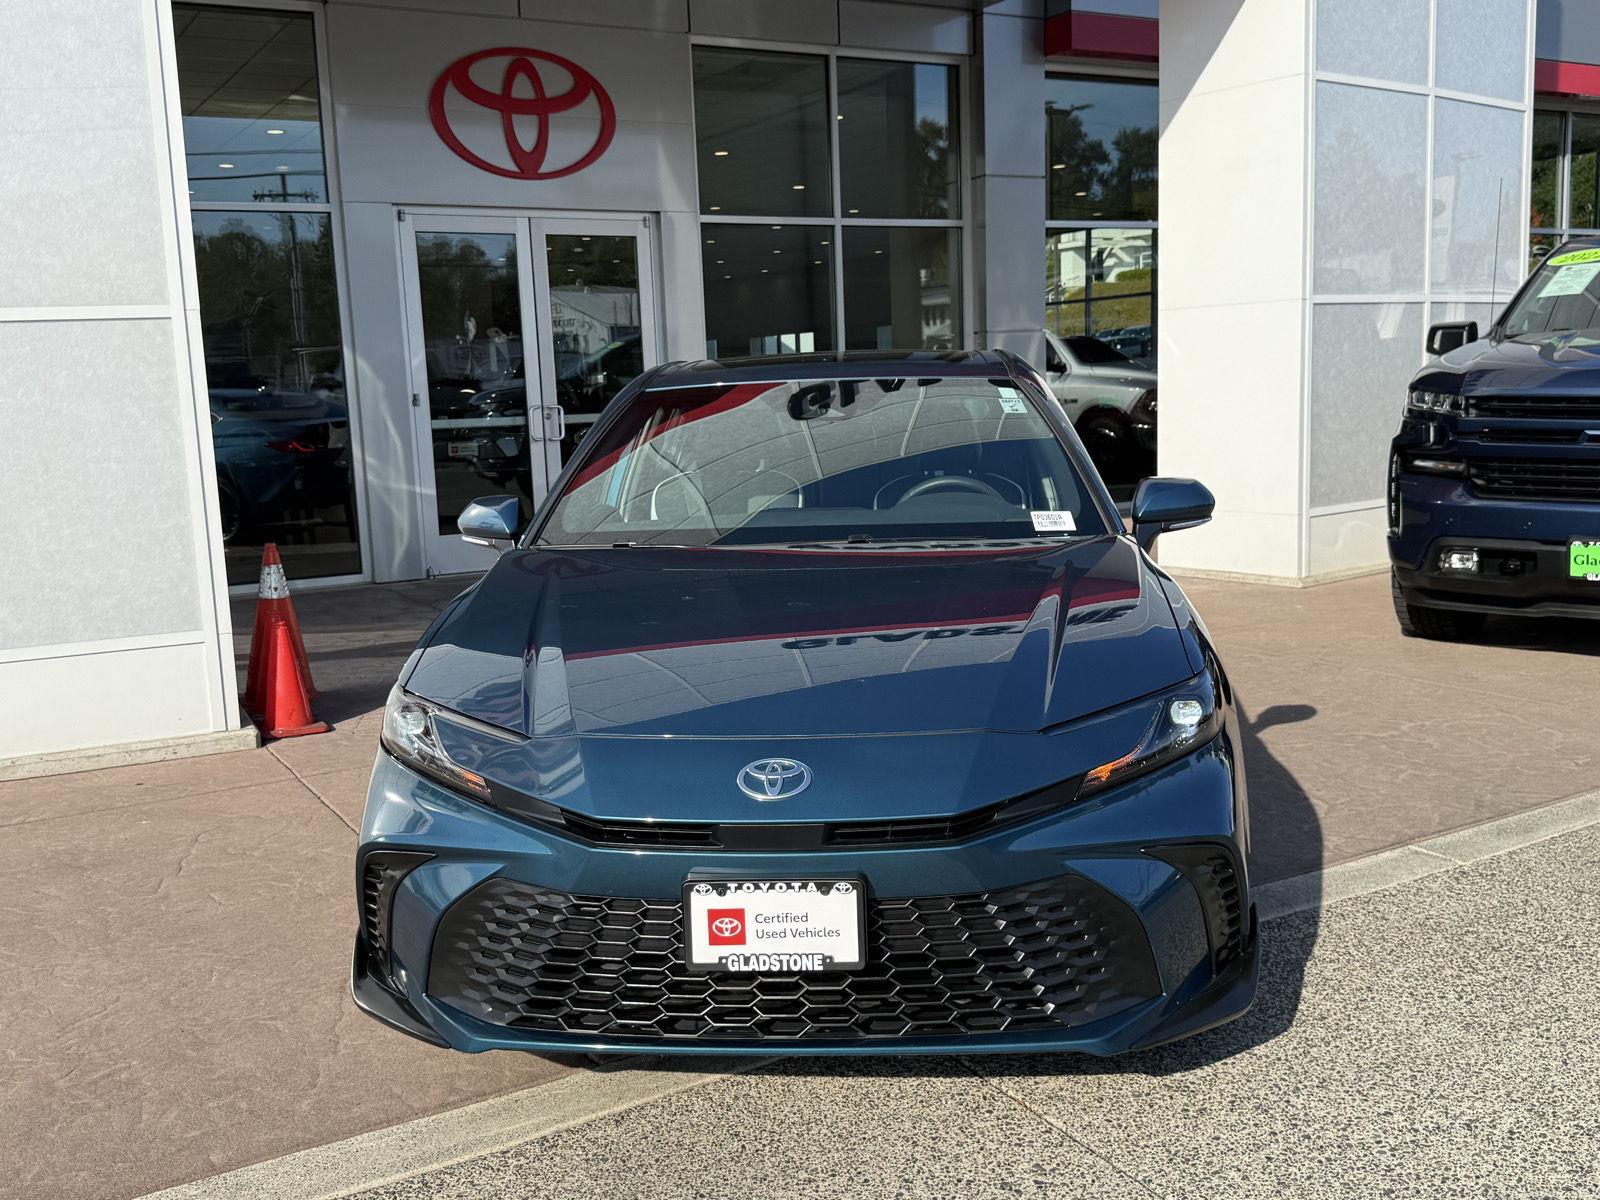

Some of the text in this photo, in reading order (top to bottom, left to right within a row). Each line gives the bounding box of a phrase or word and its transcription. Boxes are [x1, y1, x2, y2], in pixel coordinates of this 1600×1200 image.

[1574, 554, 1600, 566] Gla
[727, 882, 818, 893] TOYOTA
[755, 912, 809, 924] Certified
[755, 926, 841, 939] Used Vehicles
[727, 954, 824, 971] GLADSTONE
